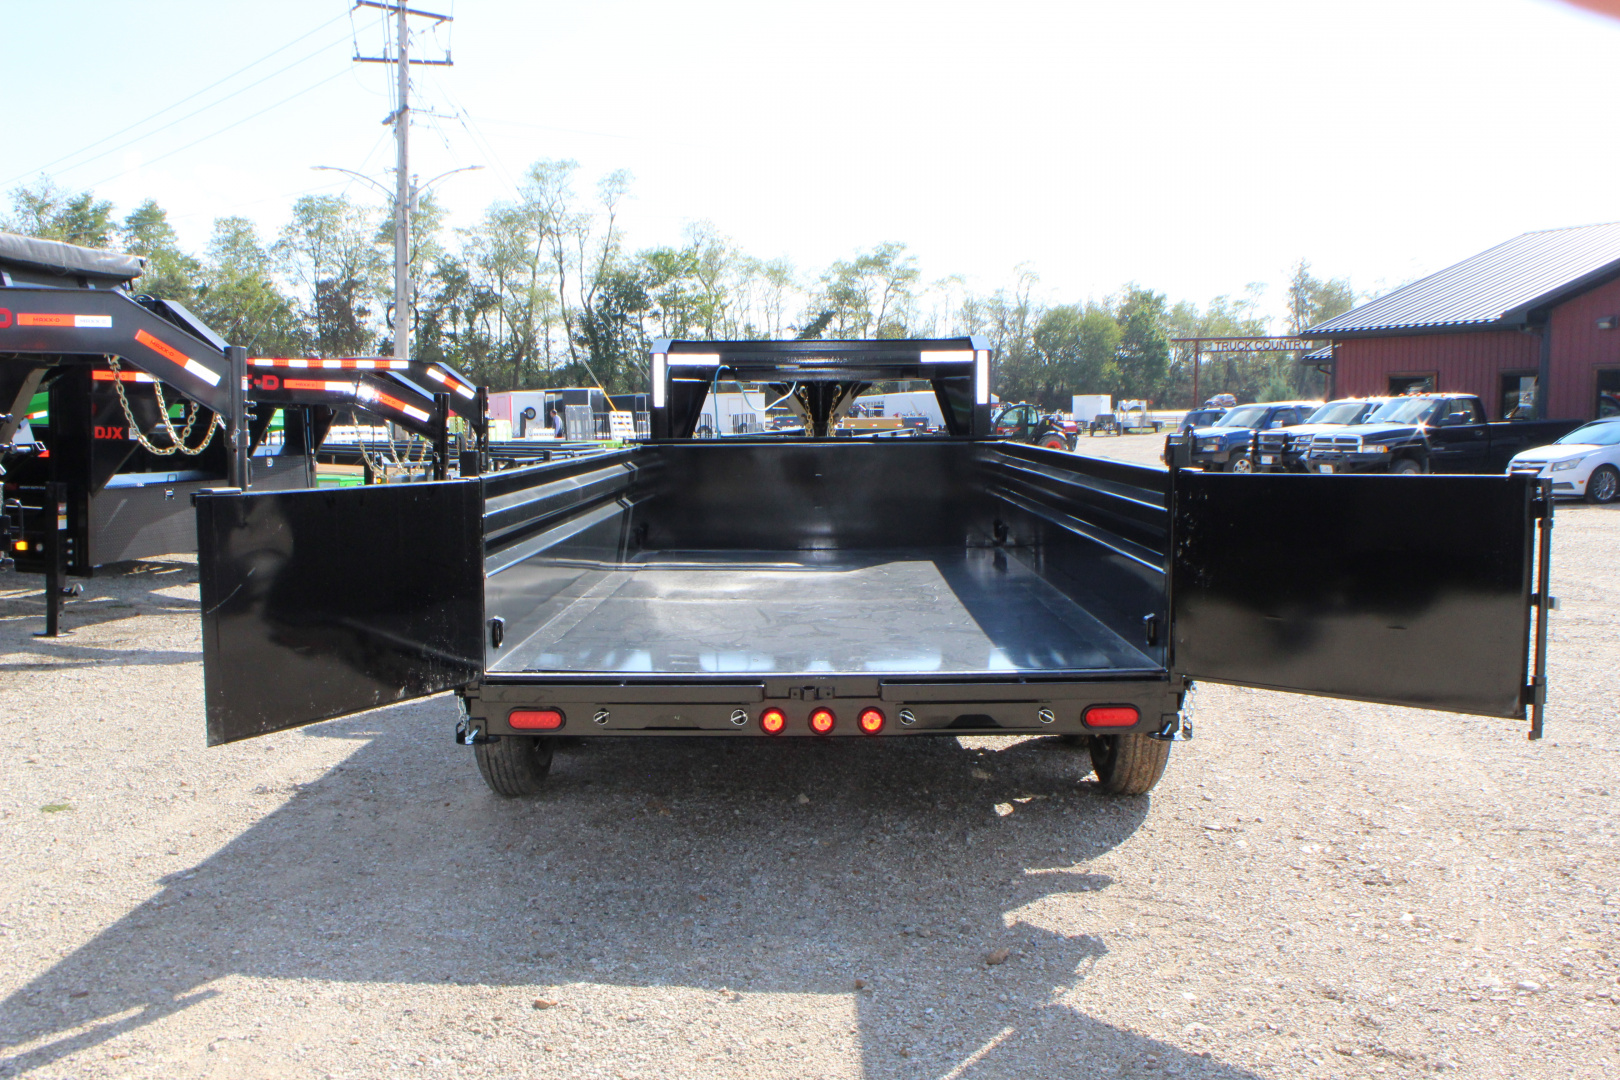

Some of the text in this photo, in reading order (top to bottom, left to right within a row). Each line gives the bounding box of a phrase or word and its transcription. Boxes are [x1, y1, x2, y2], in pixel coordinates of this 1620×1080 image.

[1215, 340, 1309, 351] TRUCK COUNTRY
[94, 426, 123, 439] DJX
